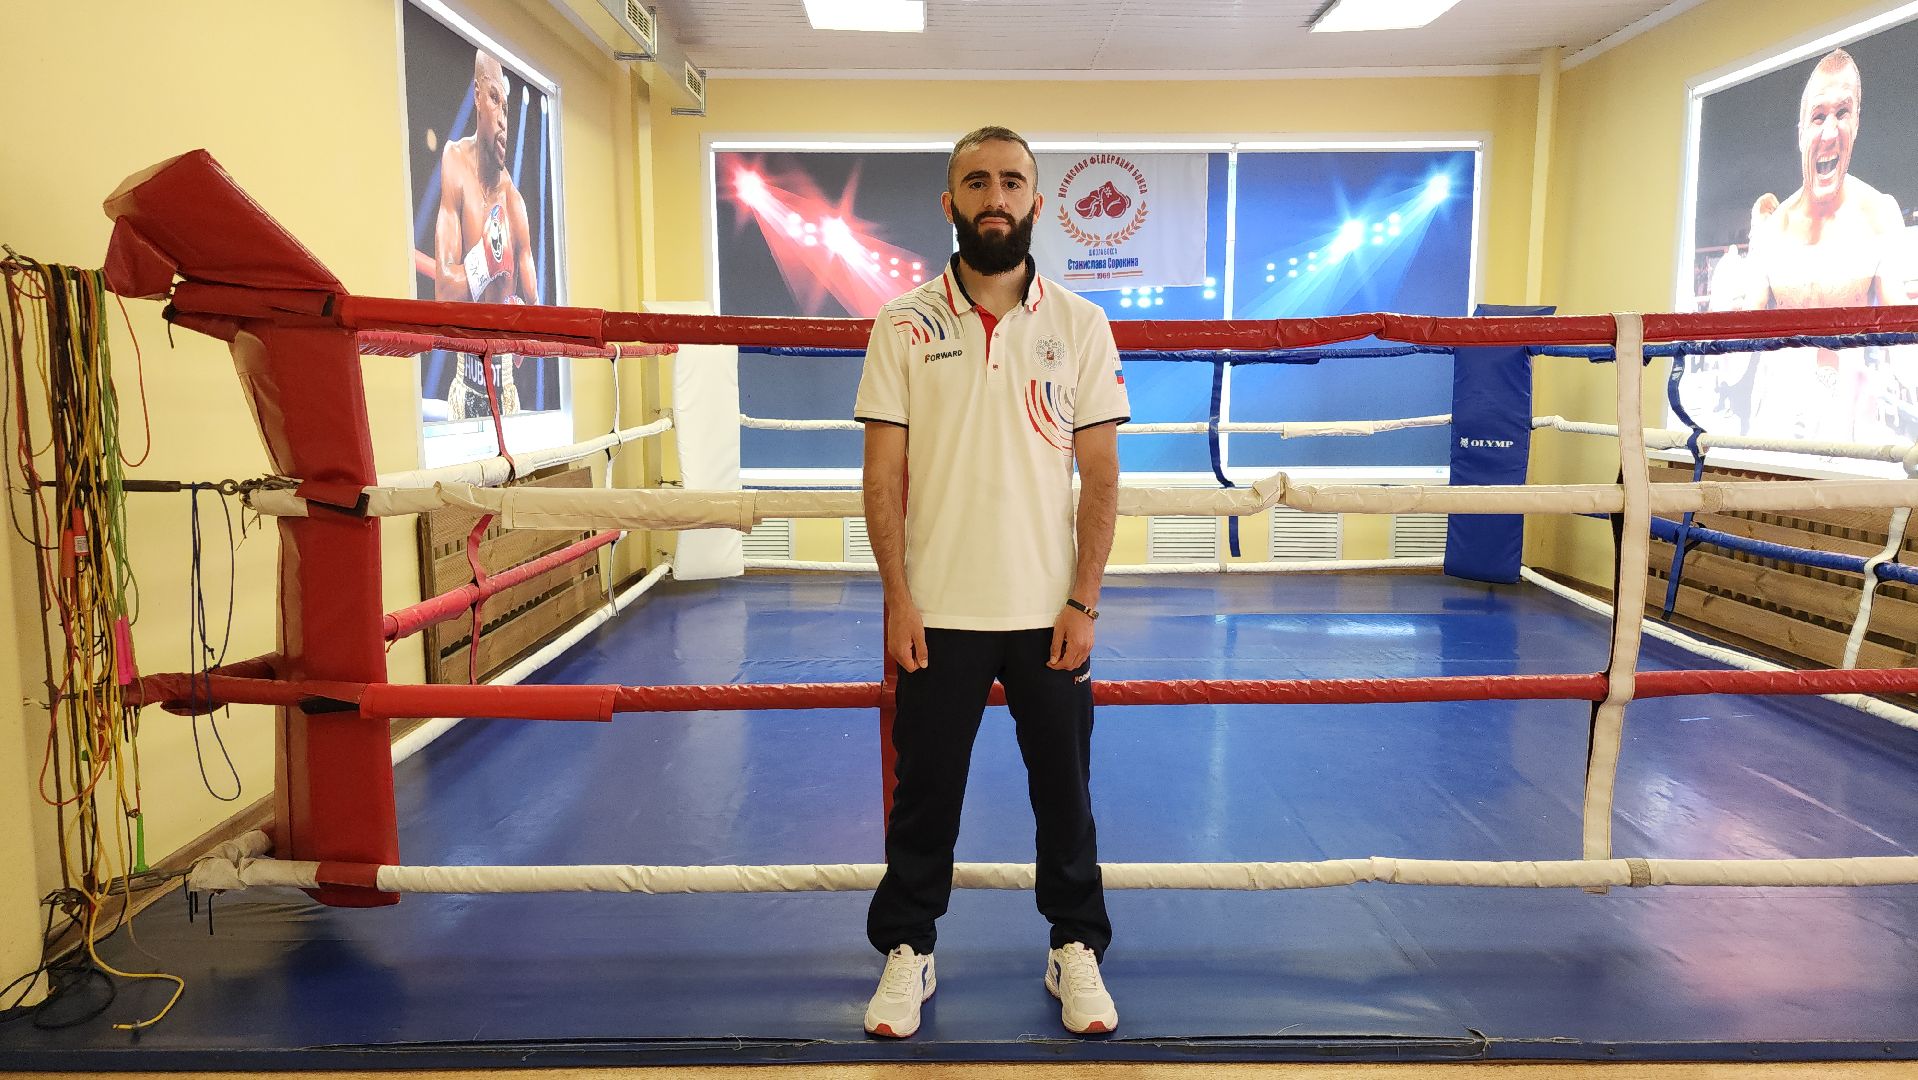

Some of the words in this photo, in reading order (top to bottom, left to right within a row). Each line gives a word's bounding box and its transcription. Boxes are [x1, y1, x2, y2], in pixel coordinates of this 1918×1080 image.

[1090, 154, 1134, 172] ФЕДЕРАЦИЯ
[1068, 259, 1106, 270] Станислава
[1108, 258, 1139, 269] Сорокина
[925, 350, 962, 363] FORWARD
[1471, 440, 1514, 448] OLYMP
